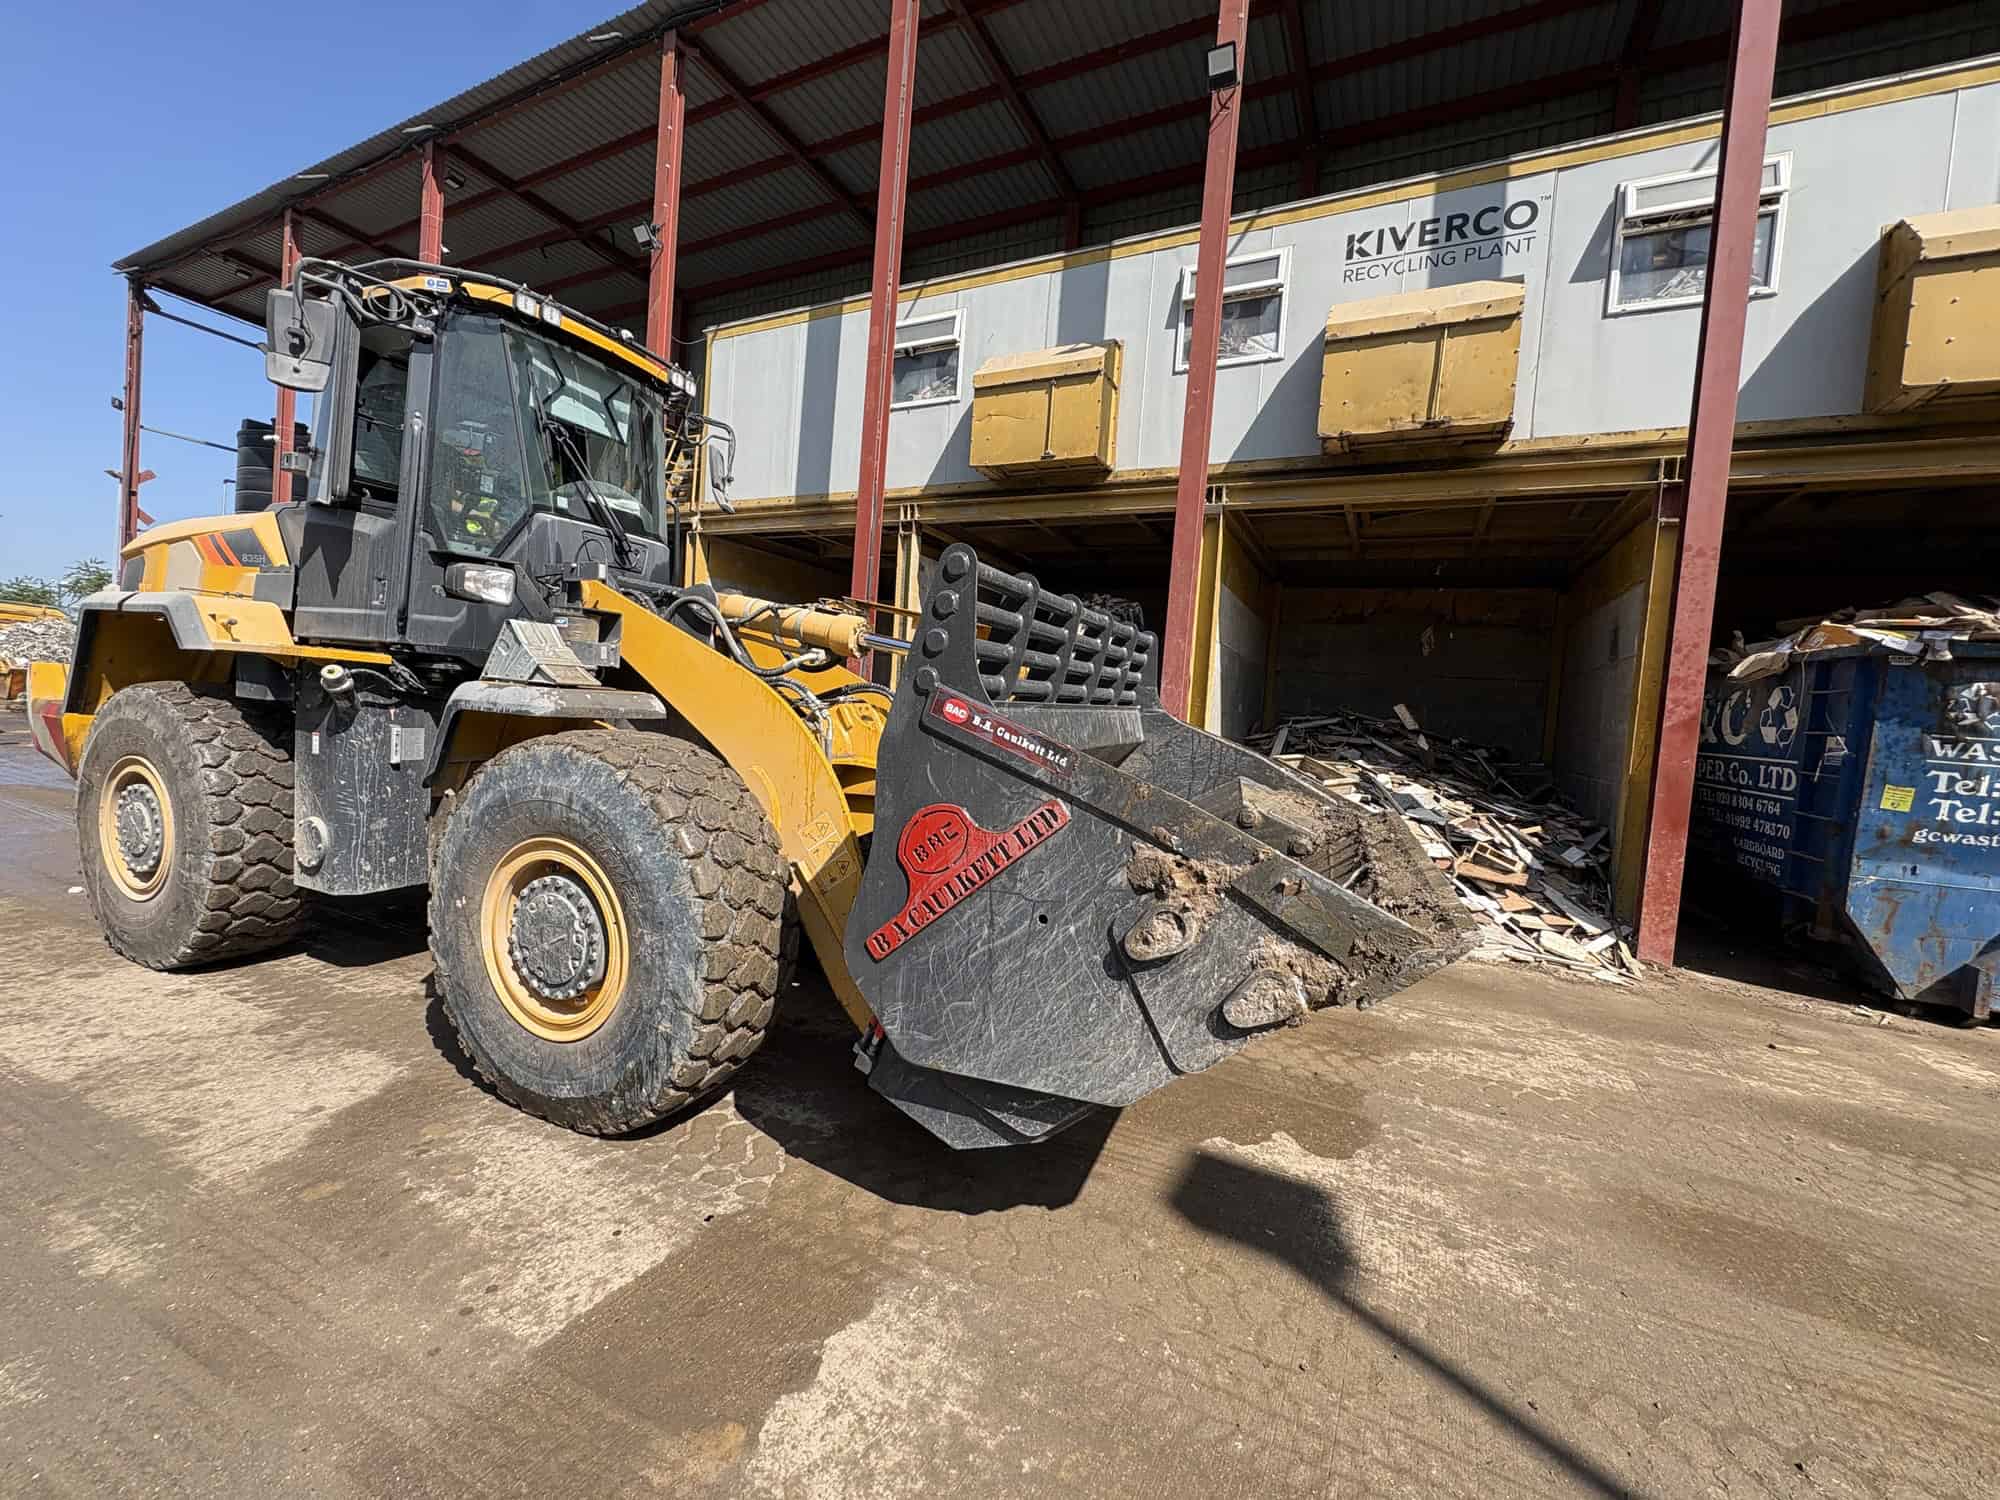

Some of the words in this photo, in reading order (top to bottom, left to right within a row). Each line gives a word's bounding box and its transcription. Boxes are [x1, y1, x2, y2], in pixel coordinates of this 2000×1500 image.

[1345, 199, 1540, 261] KIVERCO
[1343, 250, 1456, 284] RECYCLING
[1464, 236, 1537, 263] PLANT
[945, 703, 967, 719] BAC
[972, 715, 994, 732] B.A.
[996, 726, 1046, 756] Caulkett
[1047, 749, 1068, 767] Ltd
[1757, 764, 1798, 792] LTD
[1926, 770, 2000, 798] Tel:
[1928, 798, 2000, 826] Tel:
[908, 838, 1014, 928] CAULKETT
[1014, 807, 1059, 852] LTD
